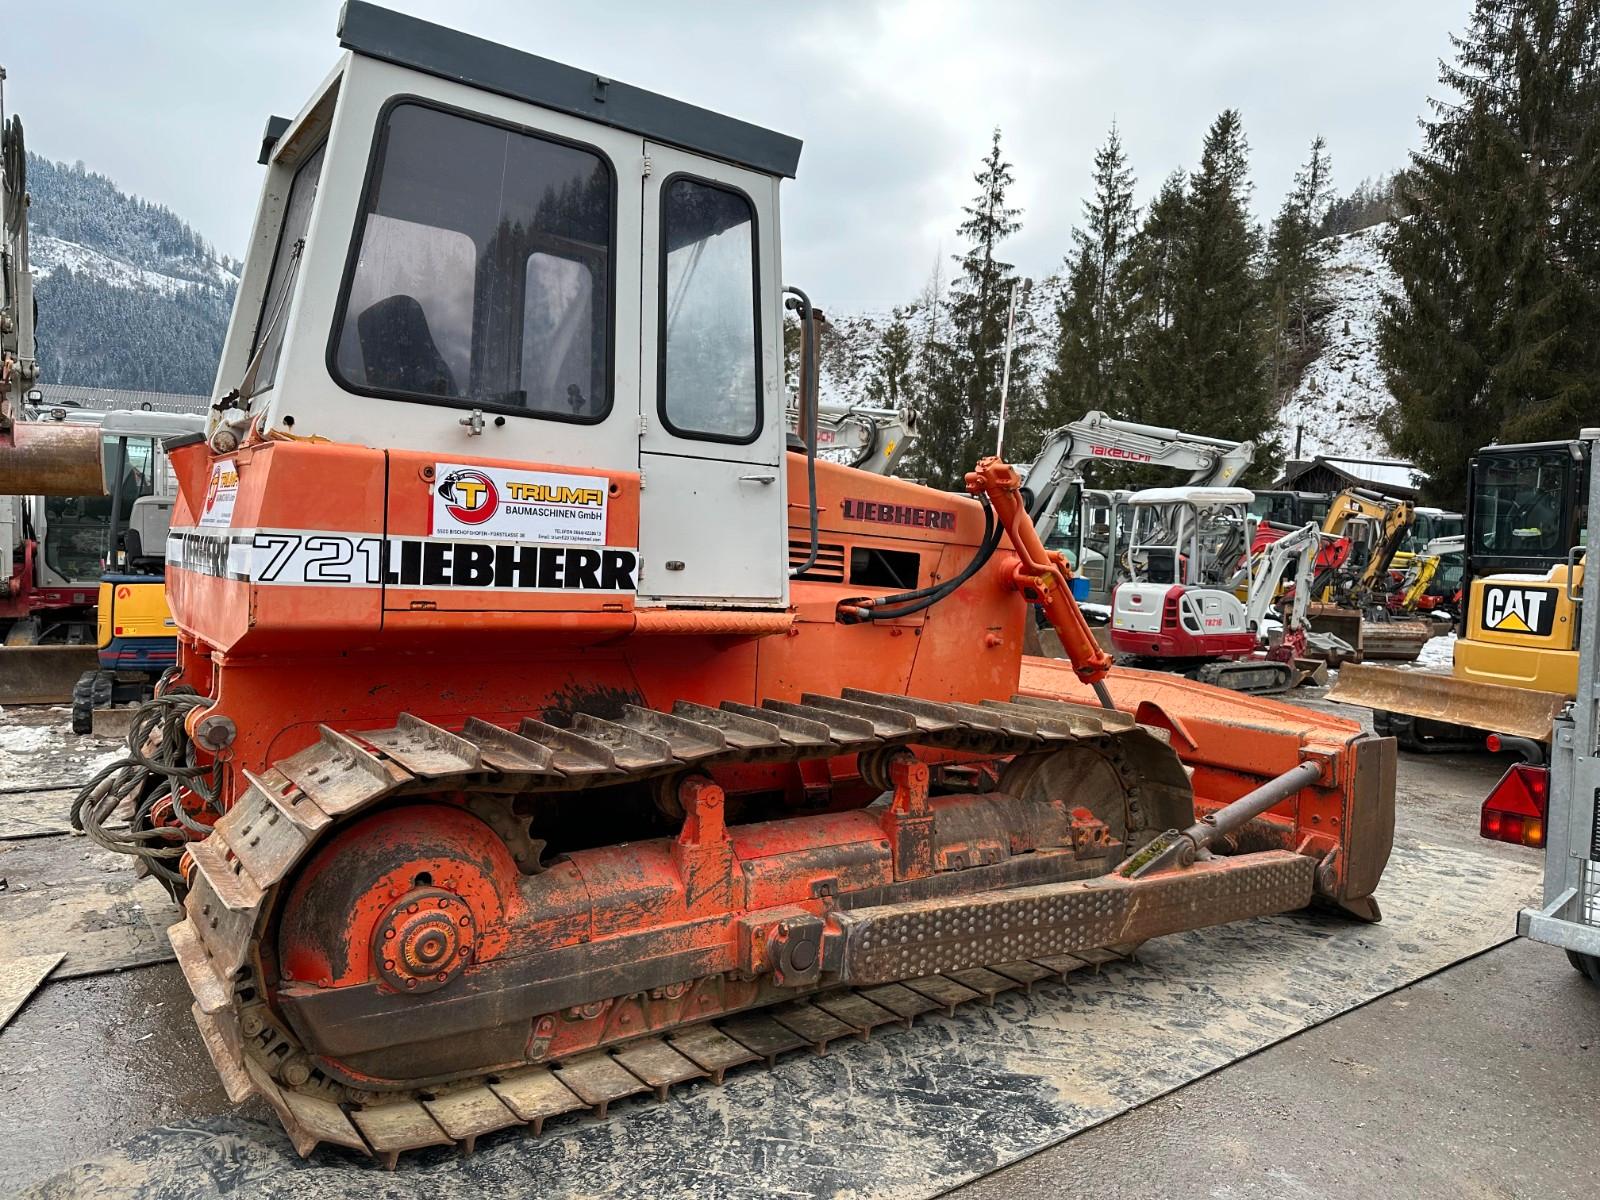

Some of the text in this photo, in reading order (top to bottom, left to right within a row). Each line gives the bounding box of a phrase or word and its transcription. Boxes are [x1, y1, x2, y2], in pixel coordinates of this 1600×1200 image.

[505, 482, 604, 507] TRIUMFI
[506, 506, 603, 521] BAUMASCHINEN GmbH
[843, 499, 956, 529] LIEBHERR
[252, 532, 637, 591] 721 LIEBHERR
[1485, 588, 1548, 632] CAT
